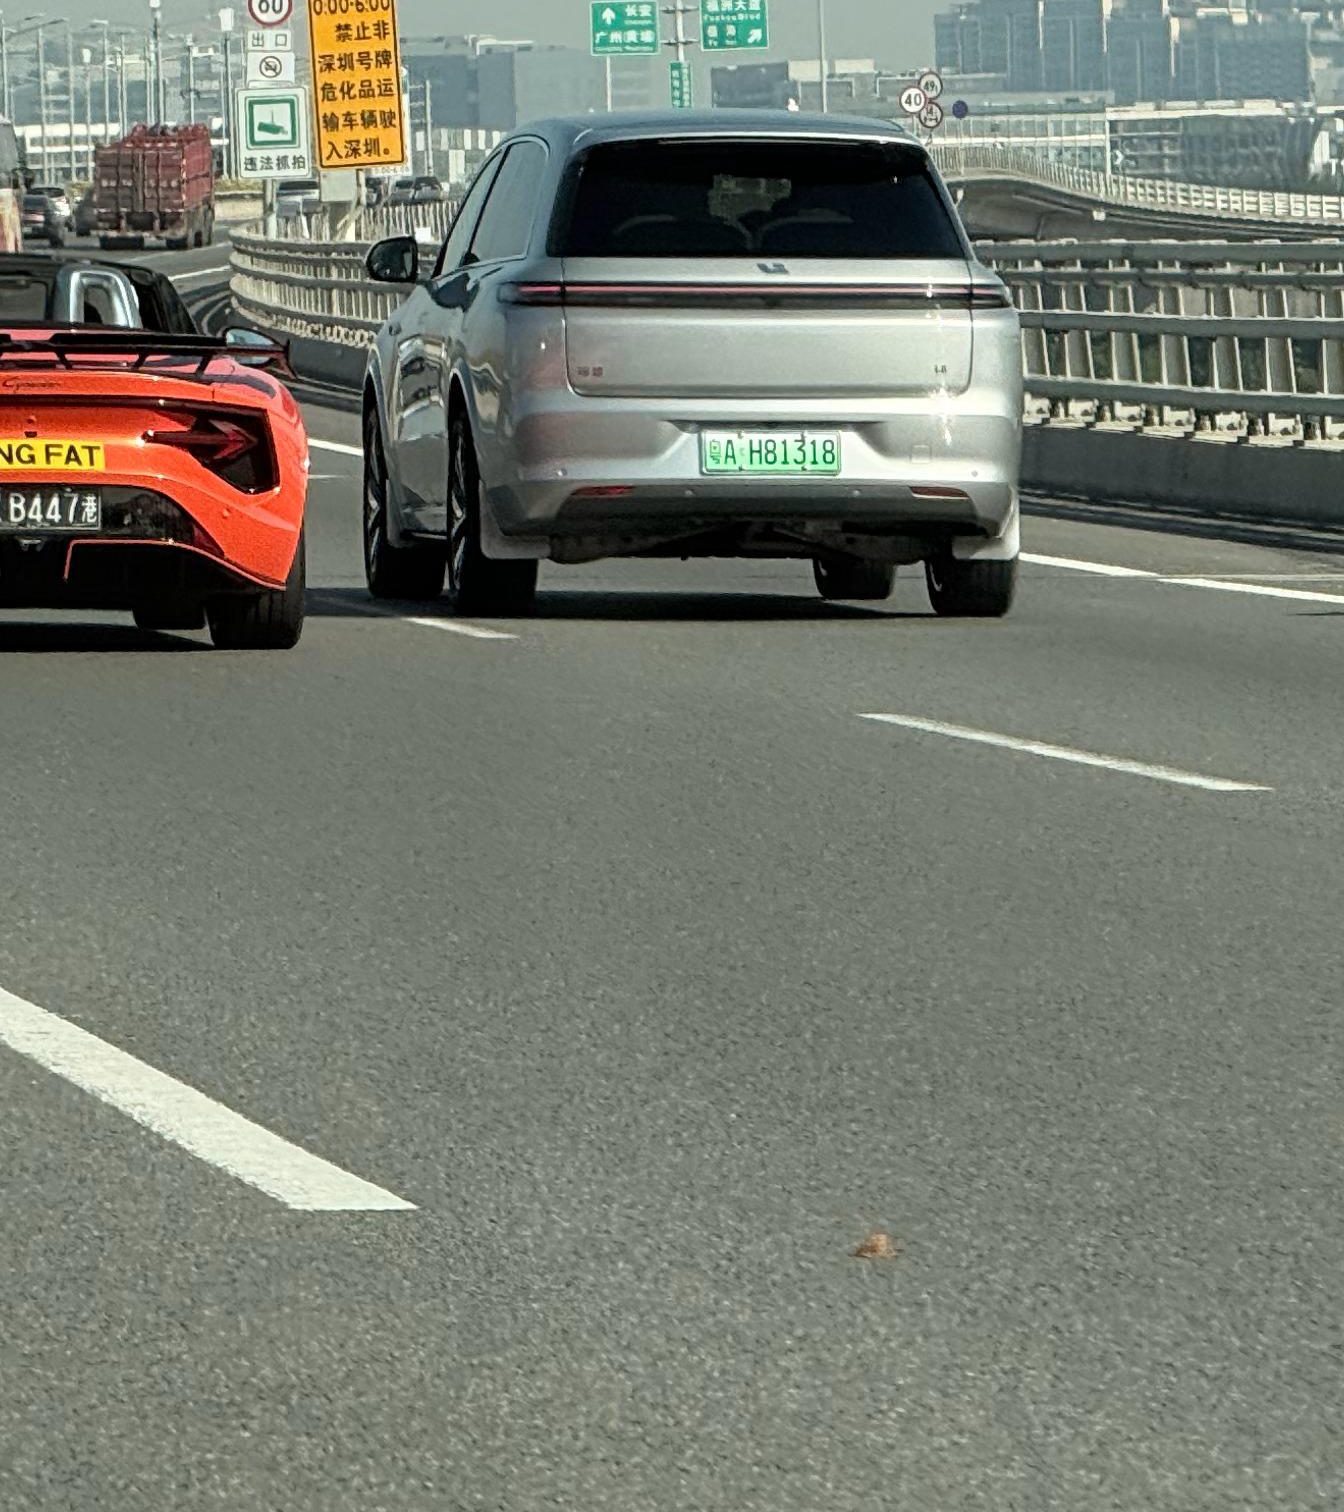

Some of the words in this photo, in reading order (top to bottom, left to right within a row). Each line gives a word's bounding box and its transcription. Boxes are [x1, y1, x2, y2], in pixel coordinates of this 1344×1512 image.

[251, 32, 288, 48] 出口
[335, 20, 391, 43] 禁止非
[318, 49, 393, 74] 深圳号牌
[321, 78, 395, 103] 危化品运
[904, 93, 922, 107] 40
[322, 109, 397, 132] 输车辆驶
[244, 154, 306, 171] 违法抓拍
[44, 443, 101, 467] FAT
